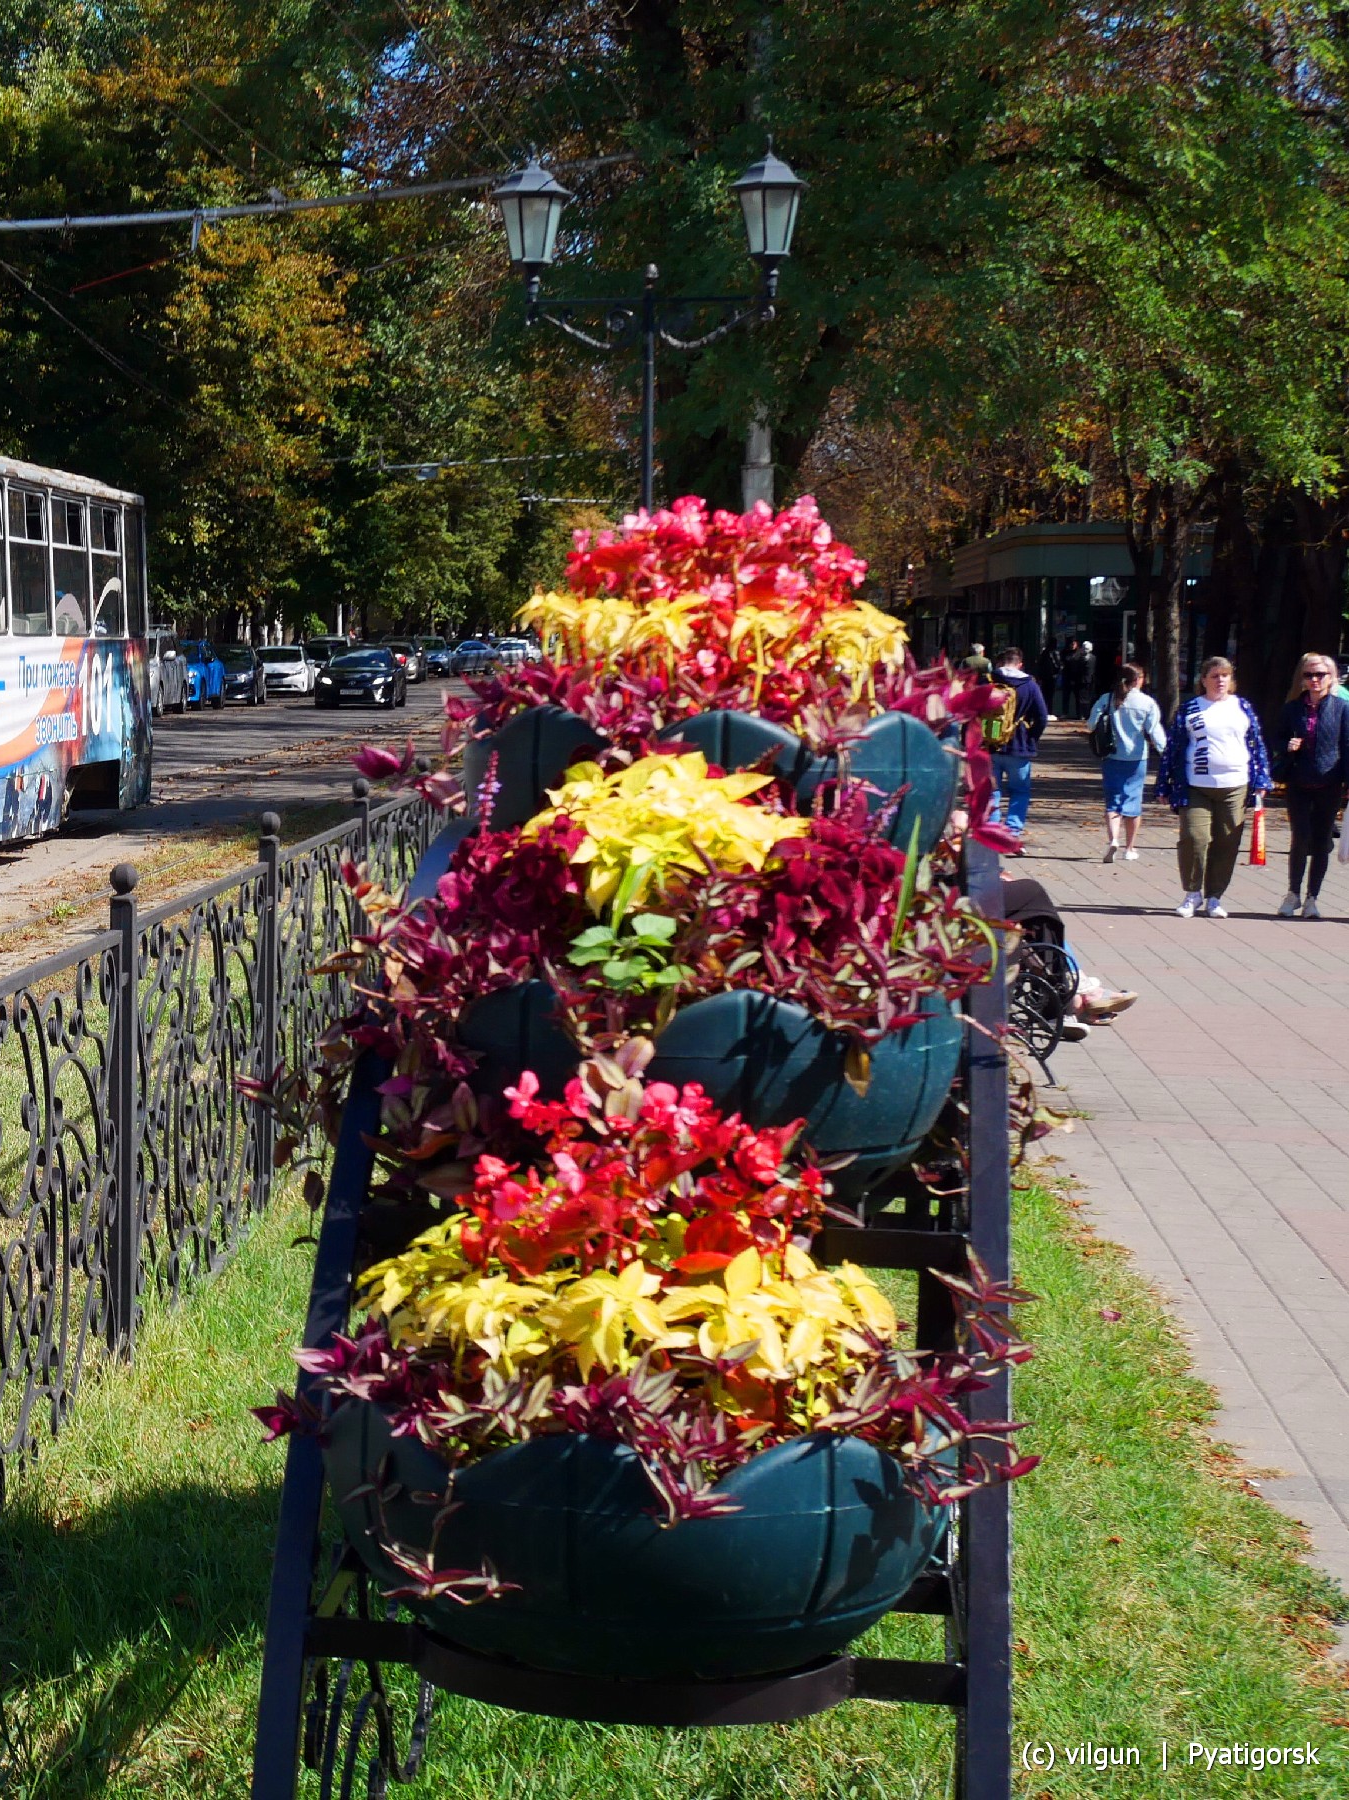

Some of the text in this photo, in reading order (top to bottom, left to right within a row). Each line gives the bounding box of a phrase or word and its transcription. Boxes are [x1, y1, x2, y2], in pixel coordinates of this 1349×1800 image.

[18, 655, 75, 698] При пожаре
[79, 652, 113, 736] 101
[35, 714, 77, 743] звонить
